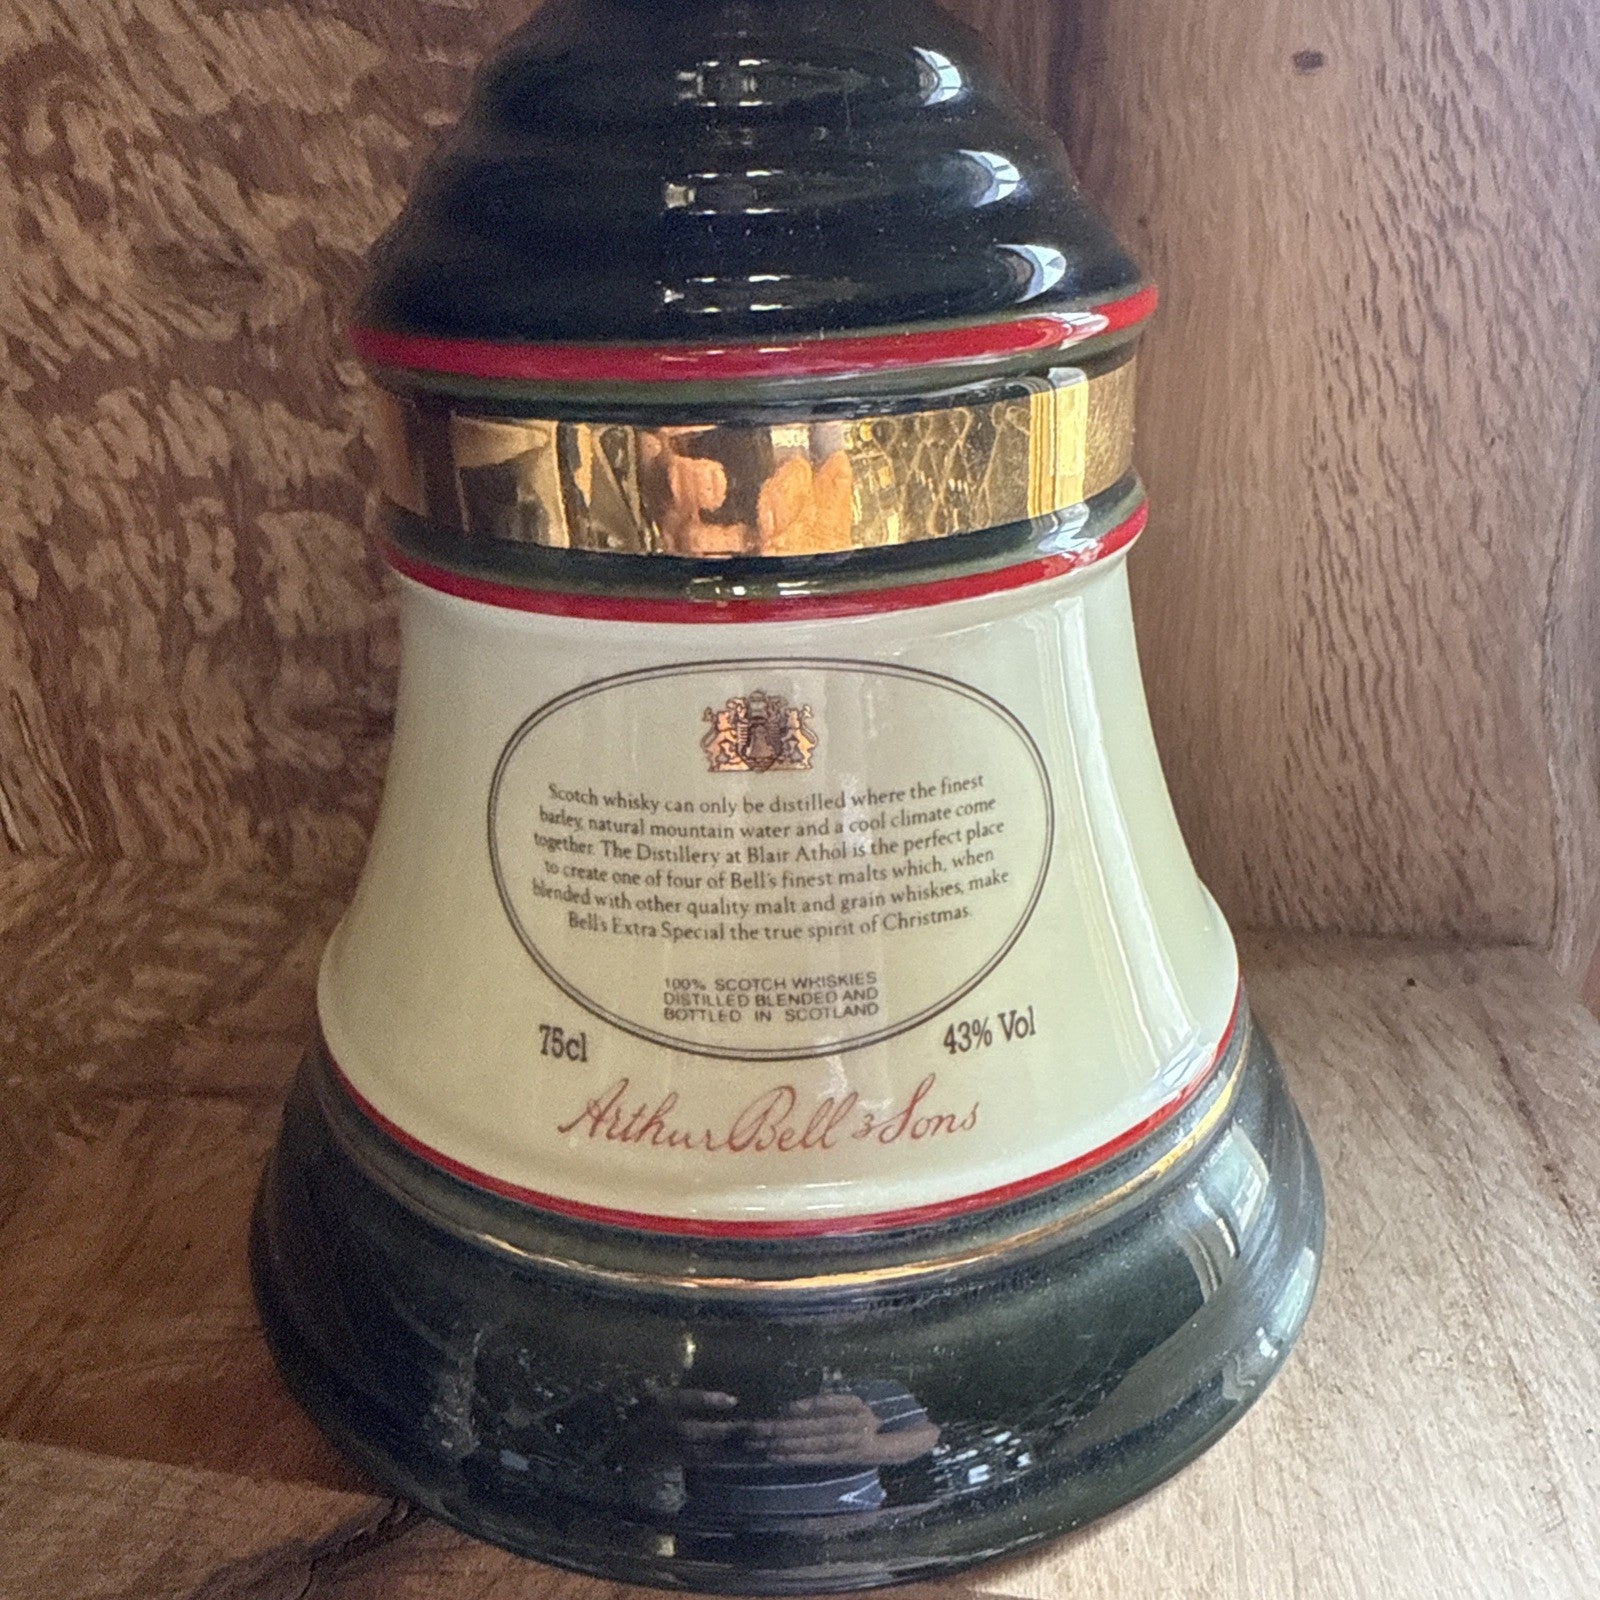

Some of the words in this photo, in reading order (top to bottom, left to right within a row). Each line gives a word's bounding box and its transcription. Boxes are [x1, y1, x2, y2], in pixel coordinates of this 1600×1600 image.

[548, 783, 598, 806] Scotch
[603, 791, 659, 814] whisky
[665, 800, 694, 813] can
[700, 797, 736, 817] only
[743, 797, 764, 813] be
[769, 791, 845, 813] distilled
[851, 788, 905, 808] where
[910, 782, 936, 799] the
[941, 775, 984, 795] finest
[589, 819, 645, 835] natural
[650, 825, 734, 839] mountain
[740, 824, 790, 838] water
[796, 819, 829, 836] and
[835, 823, 843, 835] a
[849, 812, 885, 833] cool
[890, 809, 951, 828] climate
[955, 799, 996, 817] come
[600, 840, 631, 860] The
[637, 843, 719, 867] Distillery
[726, 849, 741, 863] at
[748, 846, 789, 863] Blair
[795, 843, 847, 862] Athol
[853, 844, 866, 857] is
[871, 838, 899, 855] the
[904, 829, 962, 855] perfect
[966, 822, 1004, 844] place
[544, 861, 559, 874] to
[563, 864, 608, 882] create
[612, 872, 641, 885] one
[645, 870, 662, 887] of
[667, 872, 701, 888] four
[707, 872, 725, 889] of
[731, 872, 776, 889] Bell's
[782, 871, 833, 889] finest
[839, 865, 887, 885] malts
[892, 856, 946, 878] which,
[952, 850, 994, 869] when
[532, 878, 590, 905] blended
[595, 892, 632, 910] with
[636, 895, 682, 914] other
[687, 898, 749, 918] quality
[755, 897, 796, 914] malt
[802, 894, 835, 913] and
[840, 893, 885, 914] grain
[891, 882, 964, 904] whiskies,
[969, 869, 1009, 891] make
[612, 917, 657, 938] Extra
[661, 921, 724, 943] Special
[730, 926, 758, 940] the
[764, 926, 802, 940] true
[808, 921, 854, 942] spirit
[860, 914, 879, 934] of
[664, 992, 749, 1007] DISTILLED
[755, 991, 838, 1006] BLENDED
[843, 987, 878, 1001] AND
[665, 978, 706, 991] 100%
[715, 978, 786, 992] SCOTCH
[792, 972, 877, 989] WHISKIES
[664, 1007, 742, 1023] BOTTLED
[755, 1010, 771, 1022] IN
[785, 1002, 879, 1022] SCOTLAND
[943, 1016, 993, 1055] 43%
[997, 1005, 1036, 1042] Vol
[539, 1024, 588, 1063] 75cl
[558, 1077, 719, 1151] Arthur
[719, 1085, 859, 1152] Bell
[873, 1073, 980, 1144] Sons
